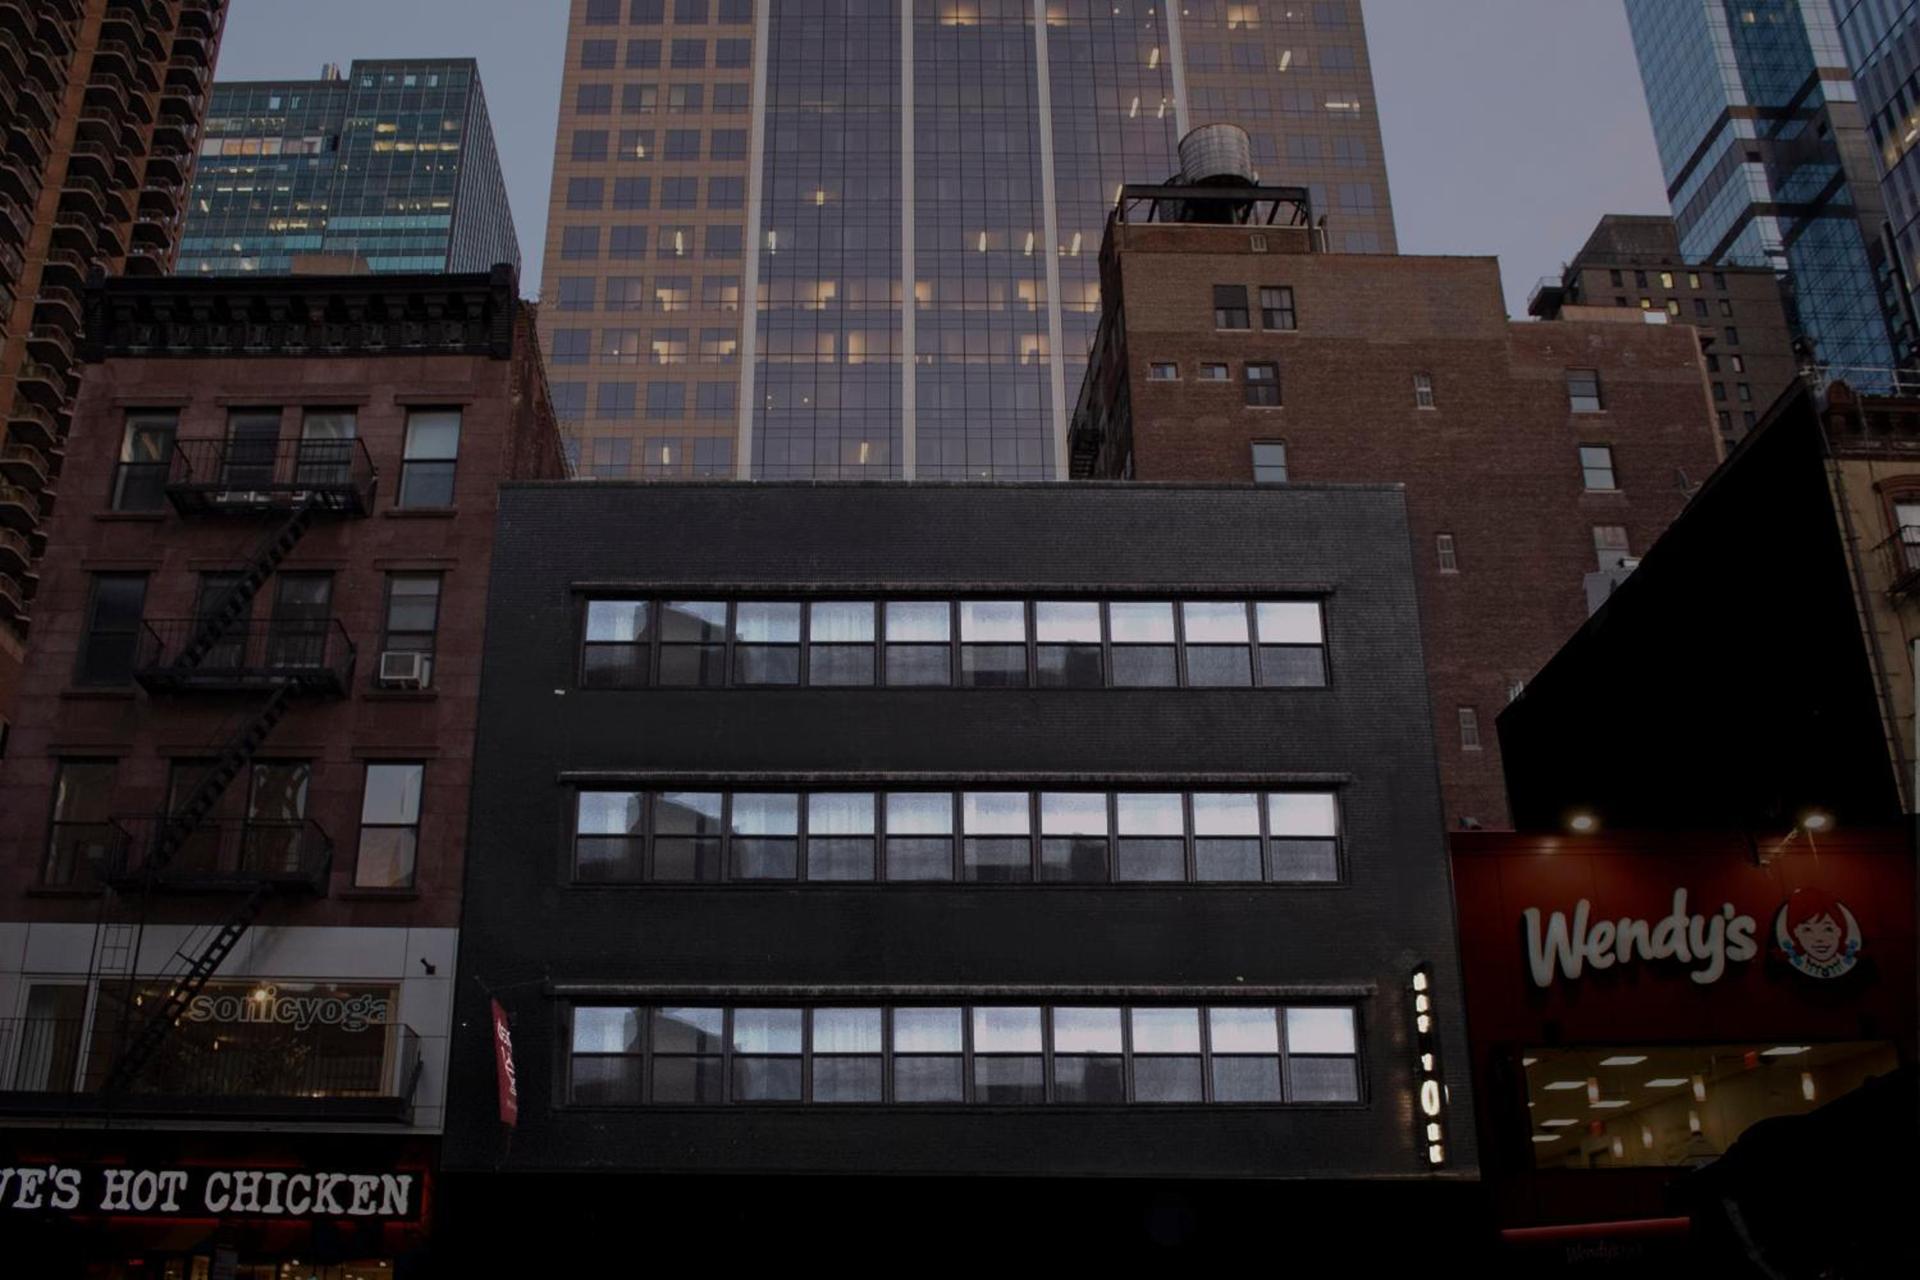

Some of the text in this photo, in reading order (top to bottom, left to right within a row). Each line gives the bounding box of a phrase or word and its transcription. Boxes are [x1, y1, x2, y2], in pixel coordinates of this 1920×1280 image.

[1523, 888, 1757, 987] Wendy's
[190, 987, 394, 1032] sonicyoga
[100, 1169, 187, 1212] HOT
[204, 1171, 413, 1215] CHICKEN
